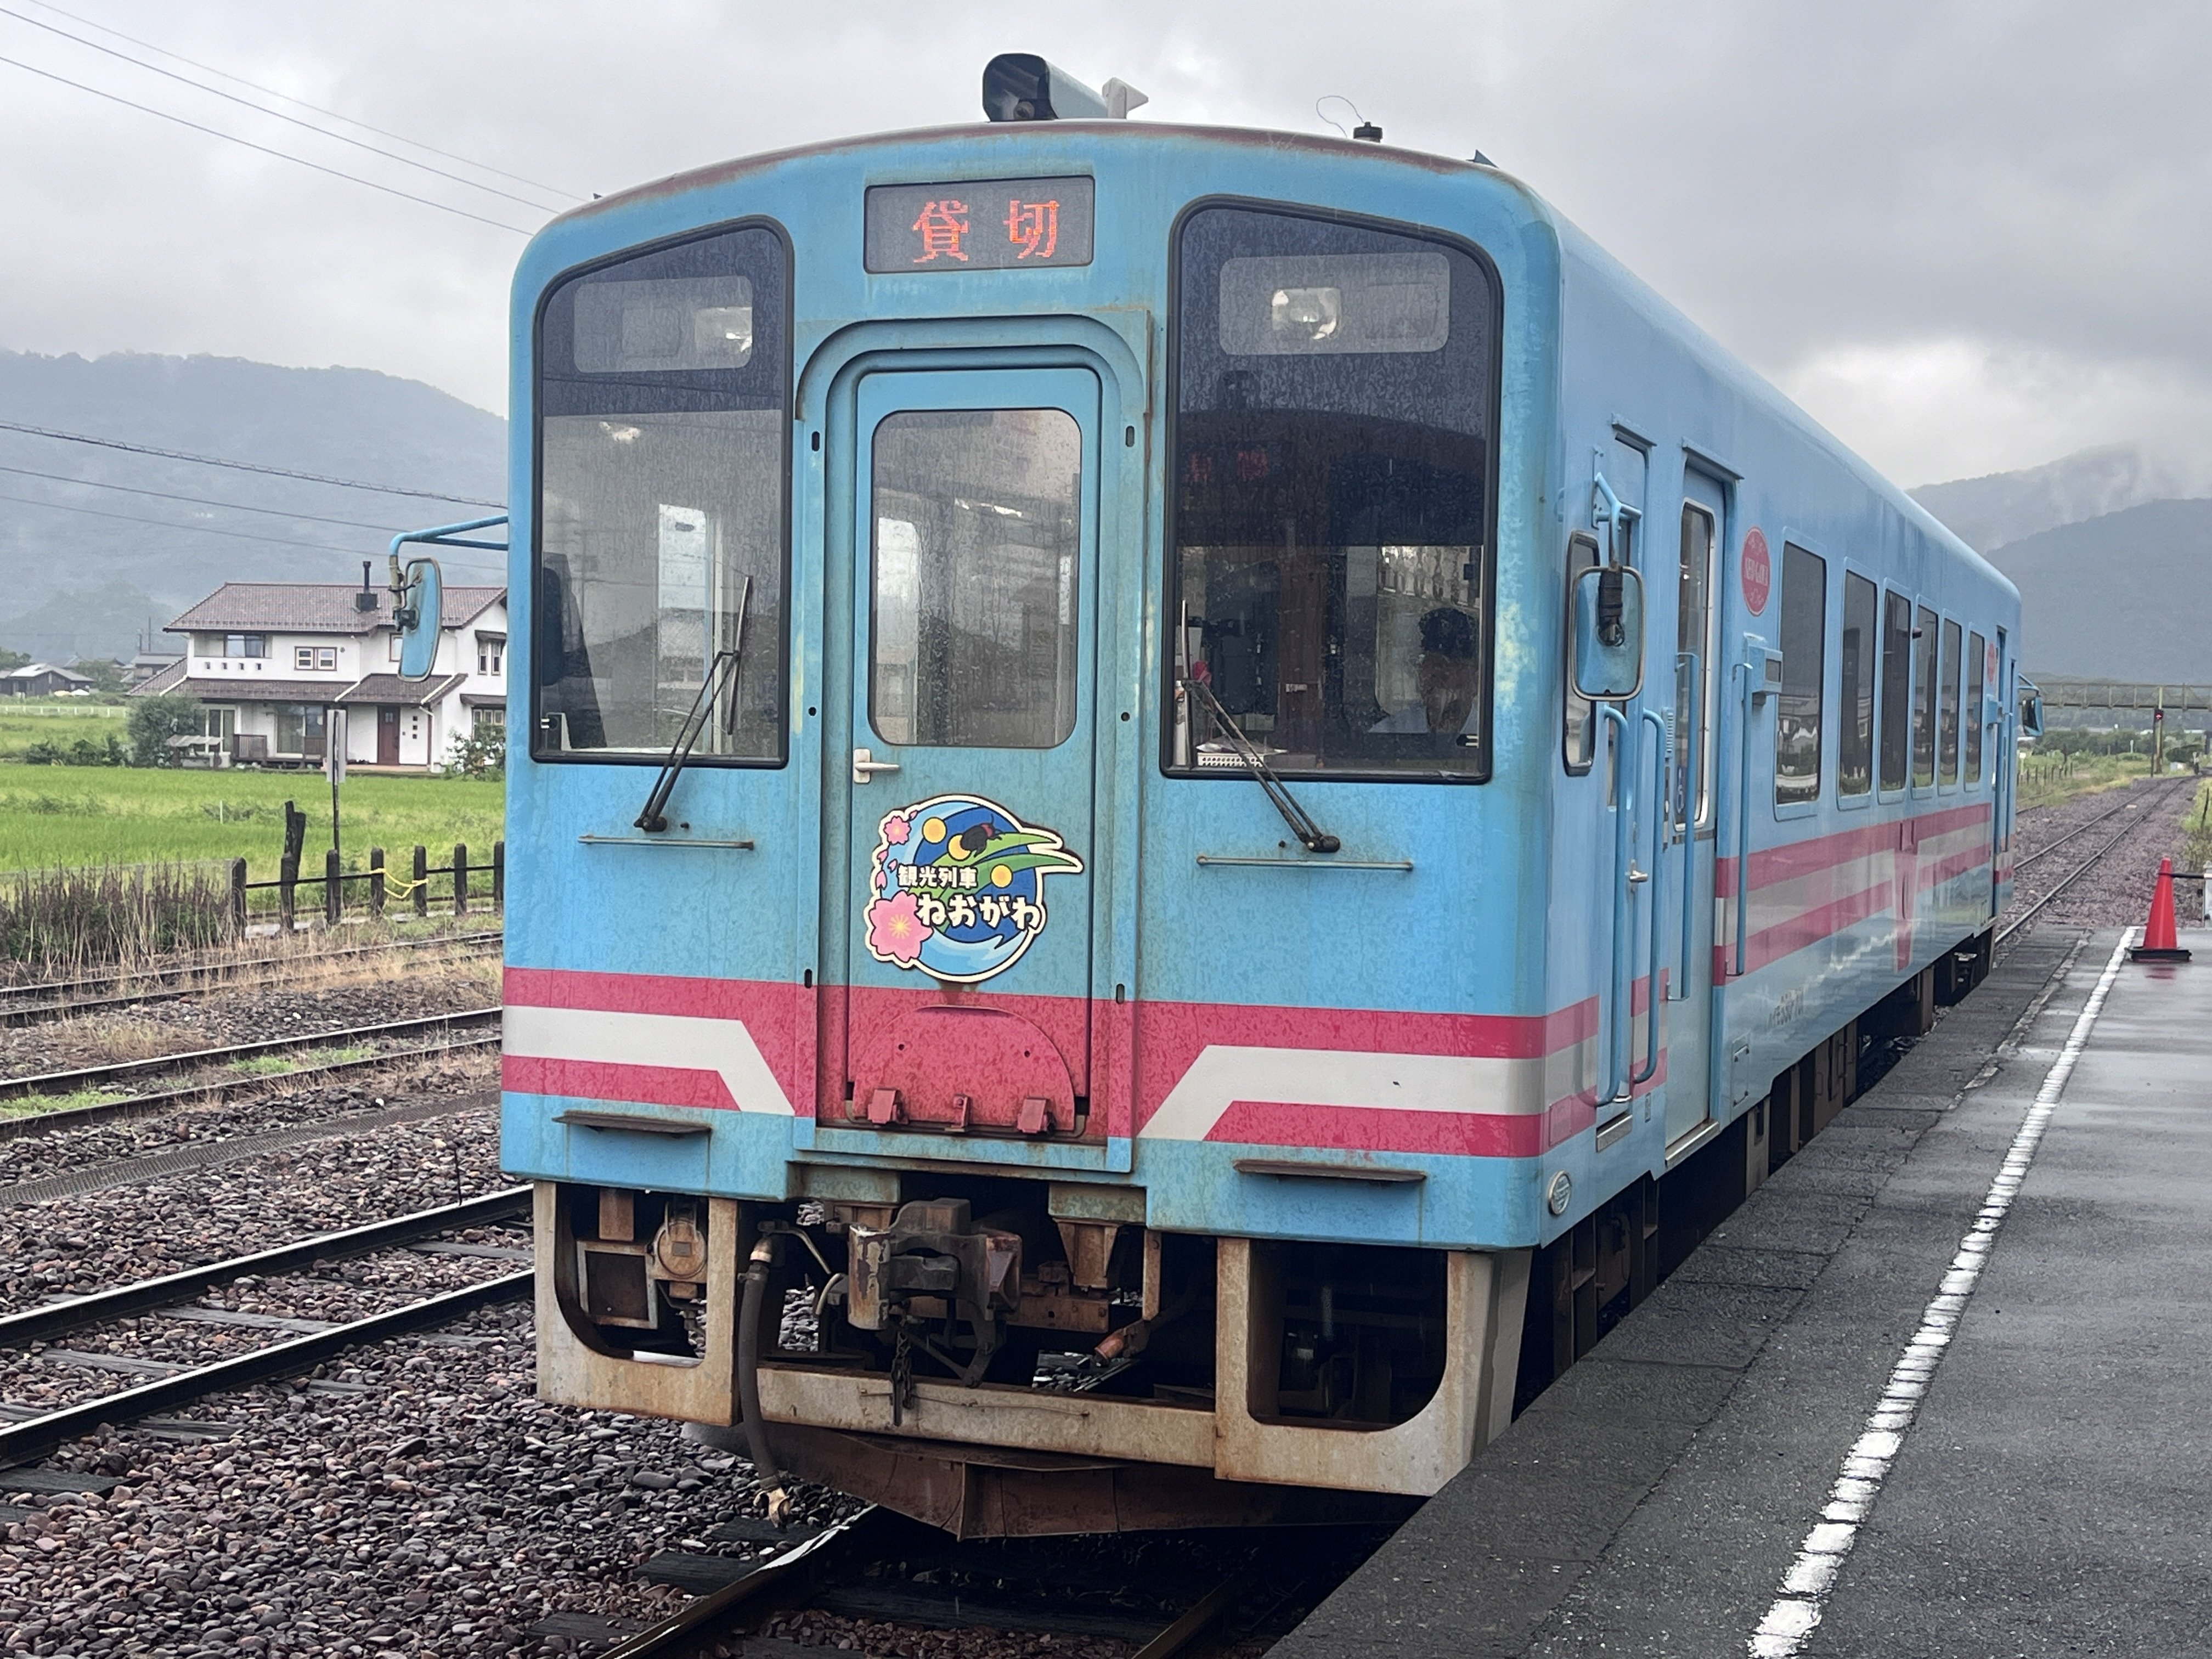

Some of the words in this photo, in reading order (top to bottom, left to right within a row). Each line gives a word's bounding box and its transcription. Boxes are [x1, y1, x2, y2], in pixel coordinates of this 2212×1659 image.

[912, 200, 1060, 263] 貸切
[898, 865, 978, 889] 観光列車
[916, 892, 1042, 931] ねおがわ
